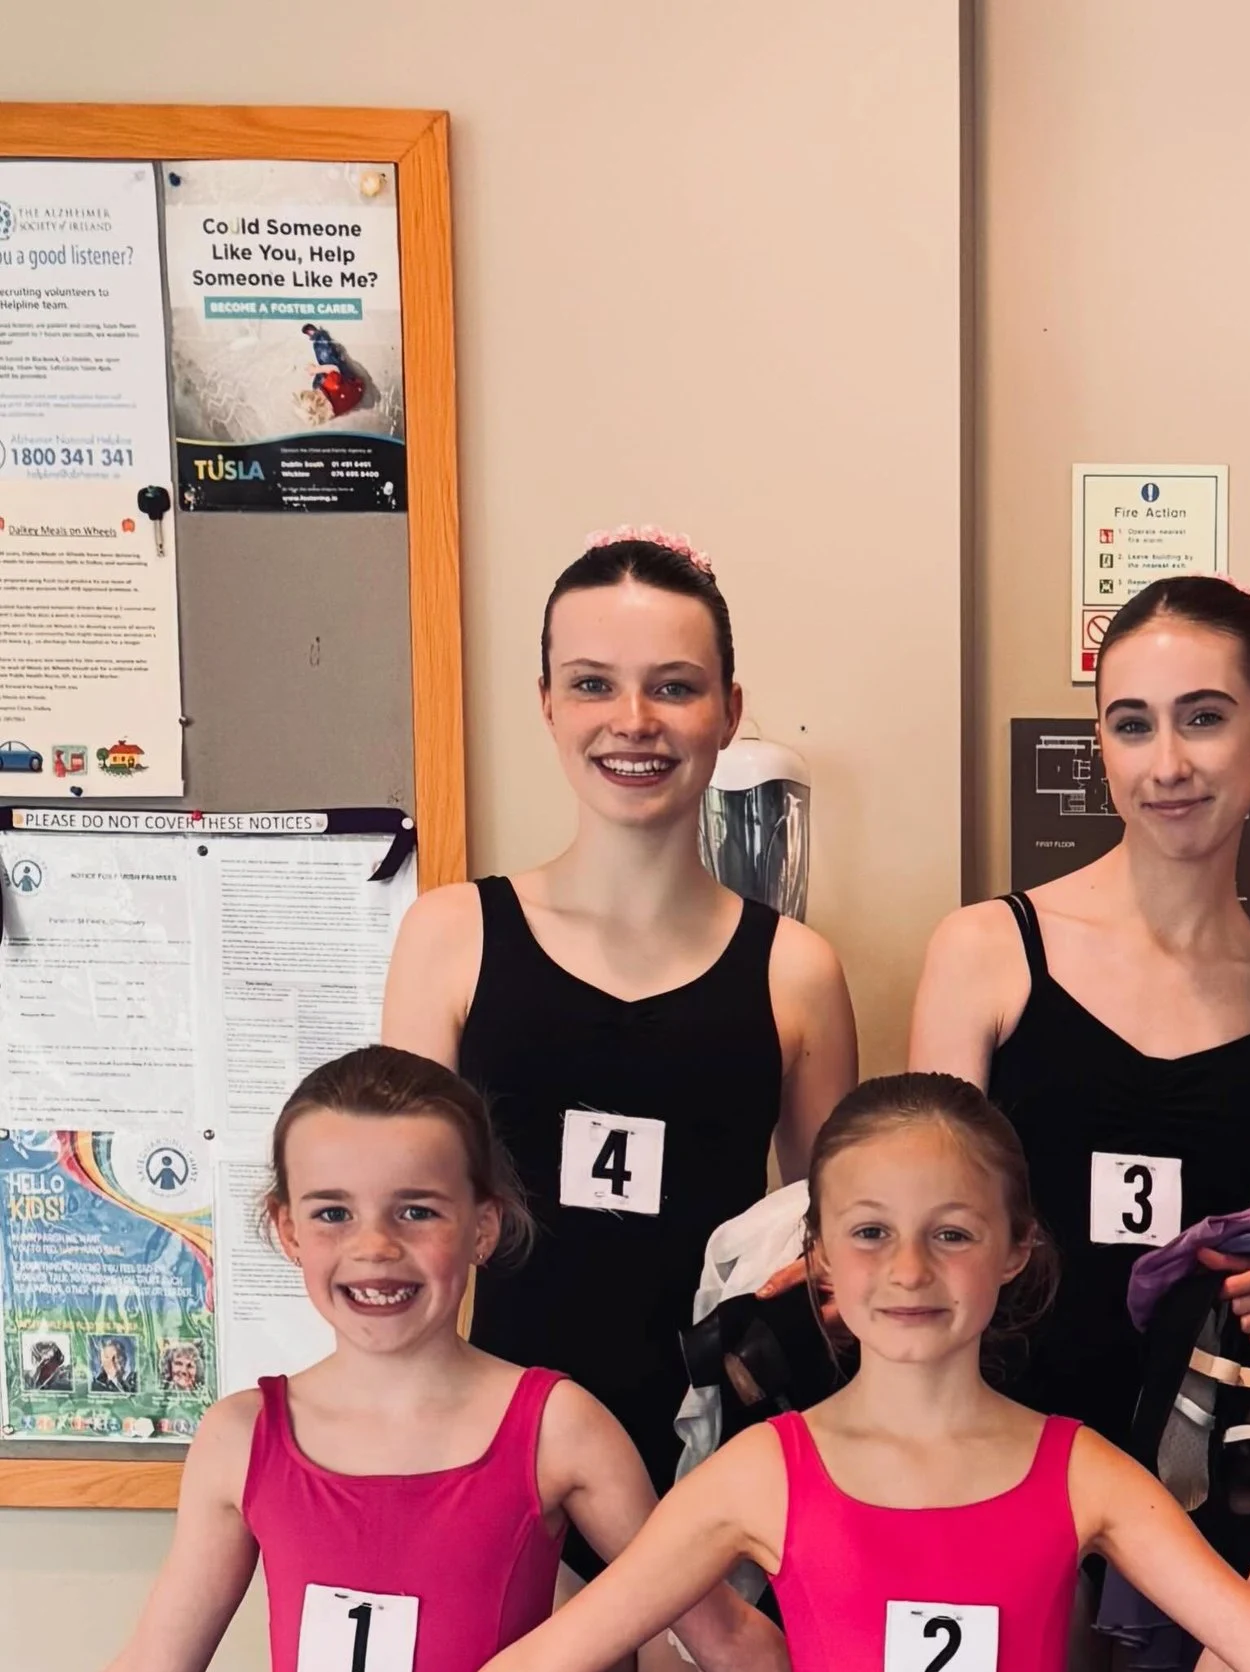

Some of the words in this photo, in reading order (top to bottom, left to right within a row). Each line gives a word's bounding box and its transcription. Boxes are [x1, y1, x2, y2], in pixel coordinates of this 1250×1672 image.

[267, 218, 362, 237] Someone
[16, 250, 25, 265] a
[28, 244, 67, 271] good
[71, 244, 134, 266] listener?
[212, 243, 252, 261] Like
[258, 244, 303, 265] You,
[309, 246, 356, 266] Help
[192, 269, 286, 287] Someone
[292, 270, 334, 288] Like
[340, 271, 379, 288] Me?
[44, 287, 97, 298] volunteers
[98, 288, 110, 298] to
[210, 302, 257, 314] BECOME
[258, 303, 269, 314] A
[270, 303, 316, 315] FOSTER
[316, 304, 359, 315] CARER.
[11, 447, 56, 466] 1800
[61, 447, 94, 466] 341
[101, 448, 134, 467] 341
[1114, 507, 1139, 518] Fire
[1145, 507, 1187, 518] Action
[8, 524, 39, 537] Dalkey
[41, 525, 67, 536] Meals
[69, 528, 82, 537] on
[84, 526, 118, 538] Wheels
[25, 812, 77, 828] PLEASE
[81, 814, 104, 829] DO
[107, 815, 139, 829] NOT
[144, 815, 195, 830] COVER
[199, 815, 244, 830] THESE
[249, 816, 312, 830] NOTICES
[591, 1128, 632, 1196] 4
[8, 1173, 65, 1195] HELLO
[10, 1195, 66, 1222] KIDS!
[1121, 1164, 1153, 1234] 3
